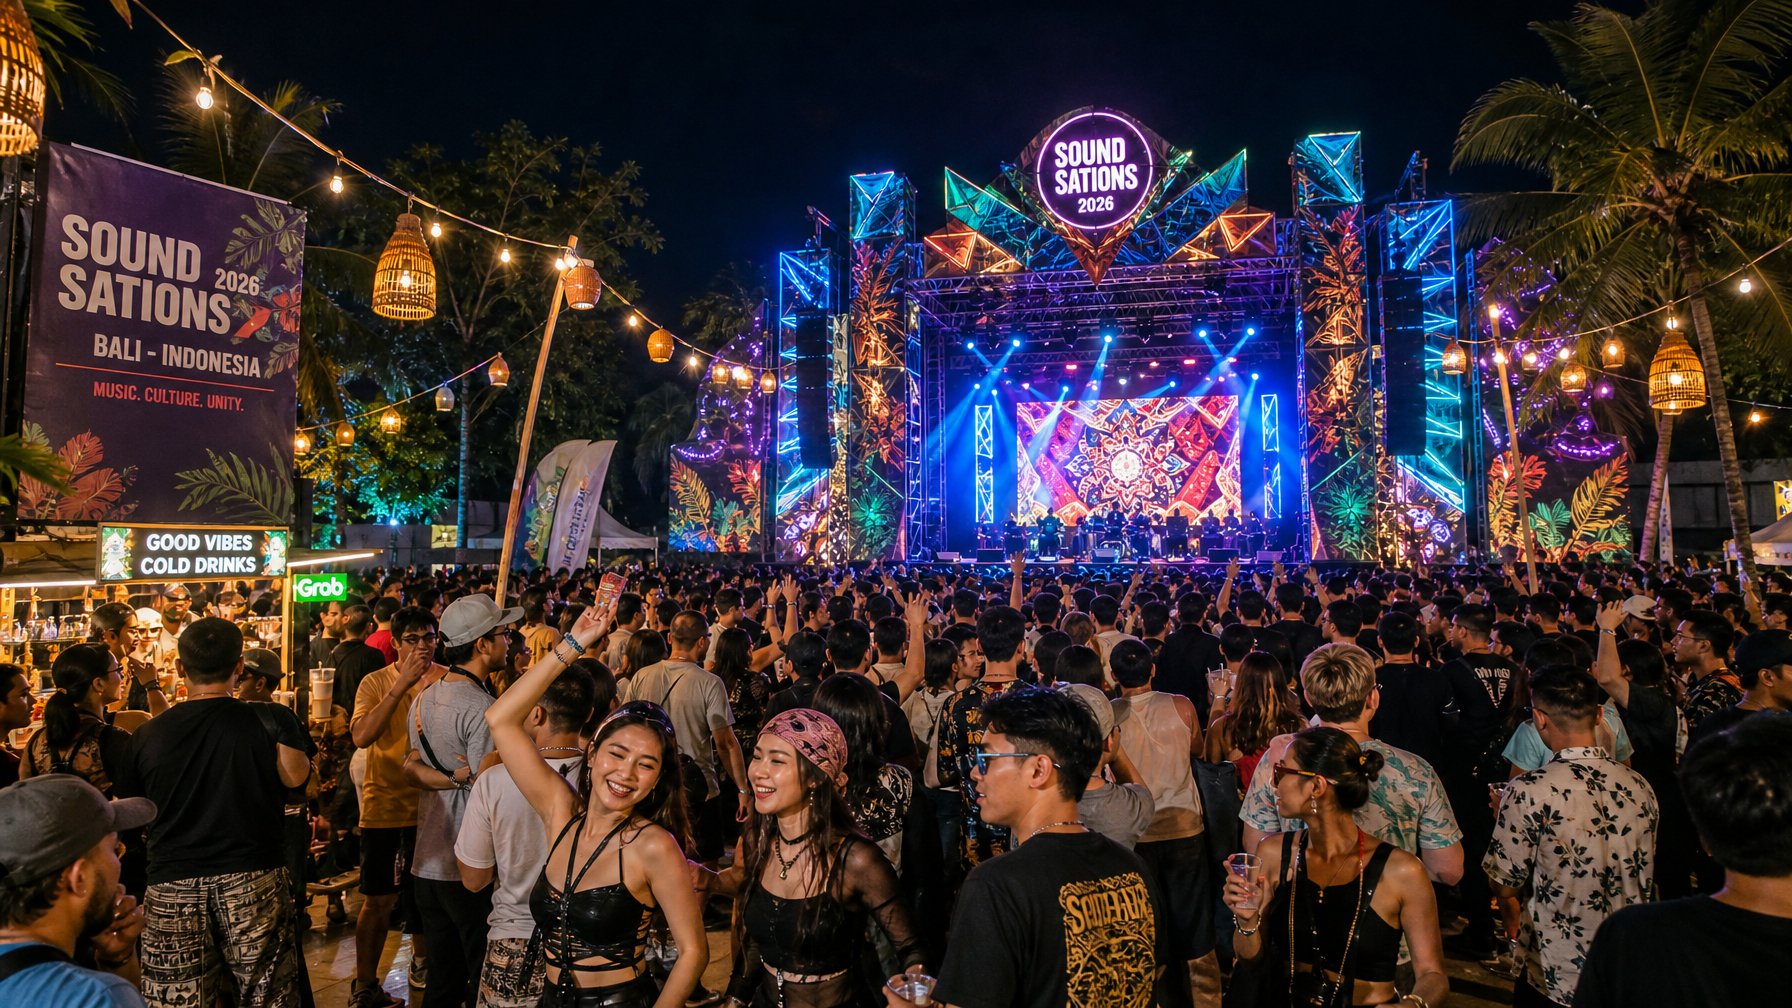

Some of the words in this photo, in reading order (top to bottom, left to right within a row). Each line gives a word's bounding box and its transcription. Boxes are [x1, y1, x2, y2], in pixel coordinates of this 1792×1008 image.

[1054, 137, 1126, 168] SOUND
[1054, 163, 1138, 195] SATIONS
[1078, 195, 1114, 213] 2026
[61, 213, 201, 283] SOUND
[215, 268, 260, 296] 2026
[58, 263, 231, 335] SATIONS
[93, 333, 142, 362] BALI
[162, 344, 261, 378] INDONESIA
[93, 381, 141, 401] MUSIC.
[144, 387, 203, 408] CULTURE.
[207, 394, 244, 412] UNITY.
[146, 533, 200, 551] GOOD
[204, 534, 253, 551] VIBES
[140, 556, 191, 574] COLD
[194, 556, 257, 573] DRINKS
